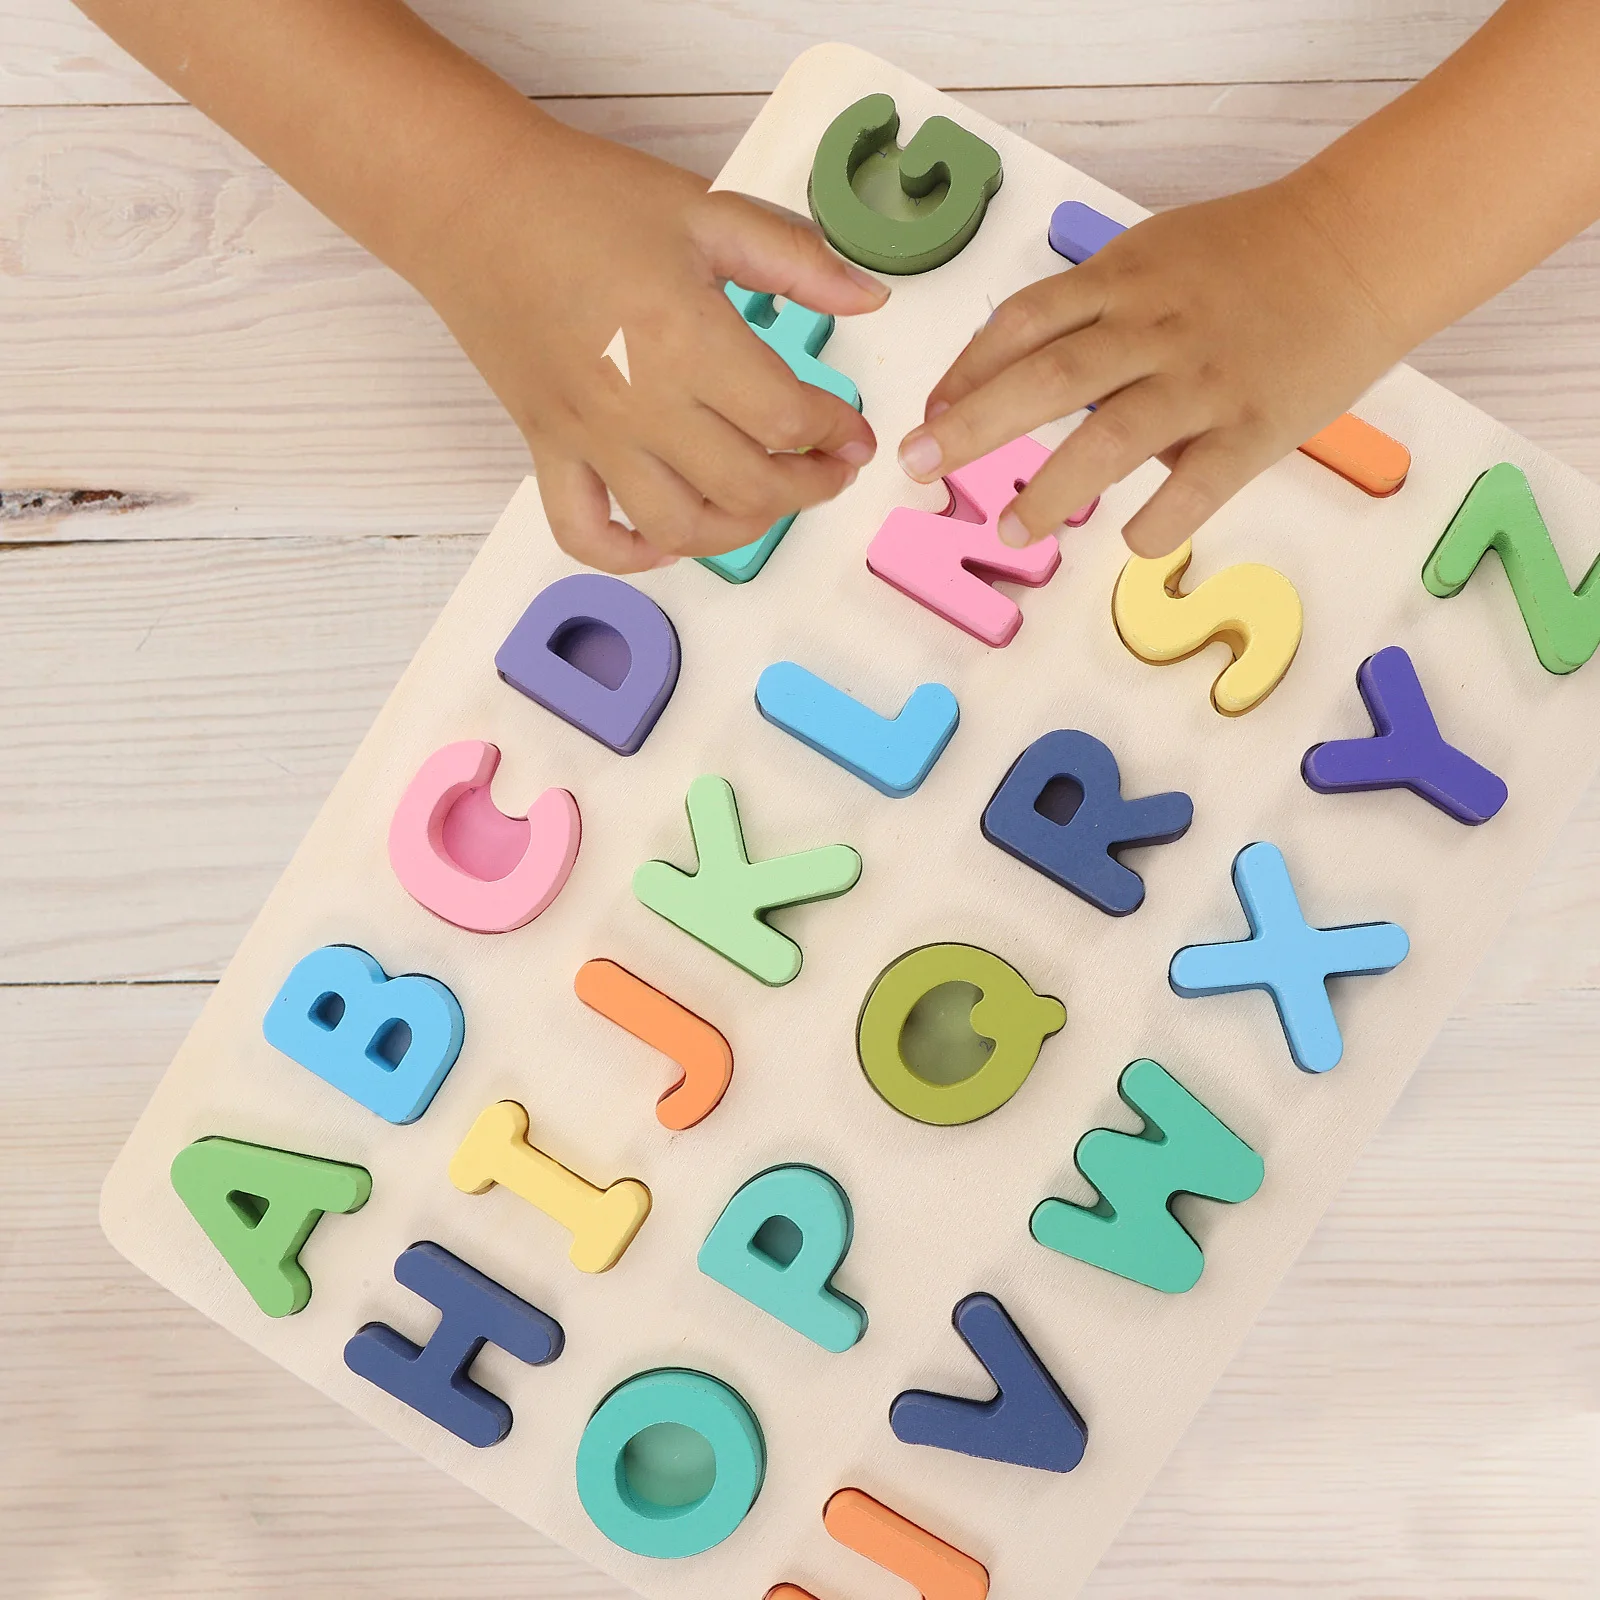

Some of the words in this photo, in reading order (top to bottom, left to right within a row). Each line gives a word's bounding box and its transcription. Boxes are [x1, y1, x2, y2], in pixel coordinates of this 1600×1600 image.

[809, 93, 1003, 275] G
[494, 574, 681, 756] D
[755, 661, 960, 798] L
[388, 740, 582, 933] C
[632, 774, 863, 987] K
[263, 944, 464, 1125] B
[574, 958, 734, 1130] J
[576, 1367, 767, 1559] O
[697, 1163, 868, 1353] P
[856, 942, 1067, 1125] Q
[980, 729, 1193, 916] R
[1113, 535, 1303, 716] S
[889, 1292, 1088, 1473] V
[1029, 1058, 1265, 1293] W
[1169, 841, 1410, 1073] X
[1301, 646, 1508, 826] Y
[1422, 462, 1600, 675] Z
[171, 1136, 373, 1318] A
[449, 1099, 652, 1274] I
[343, 1240, 565, 1448] H
